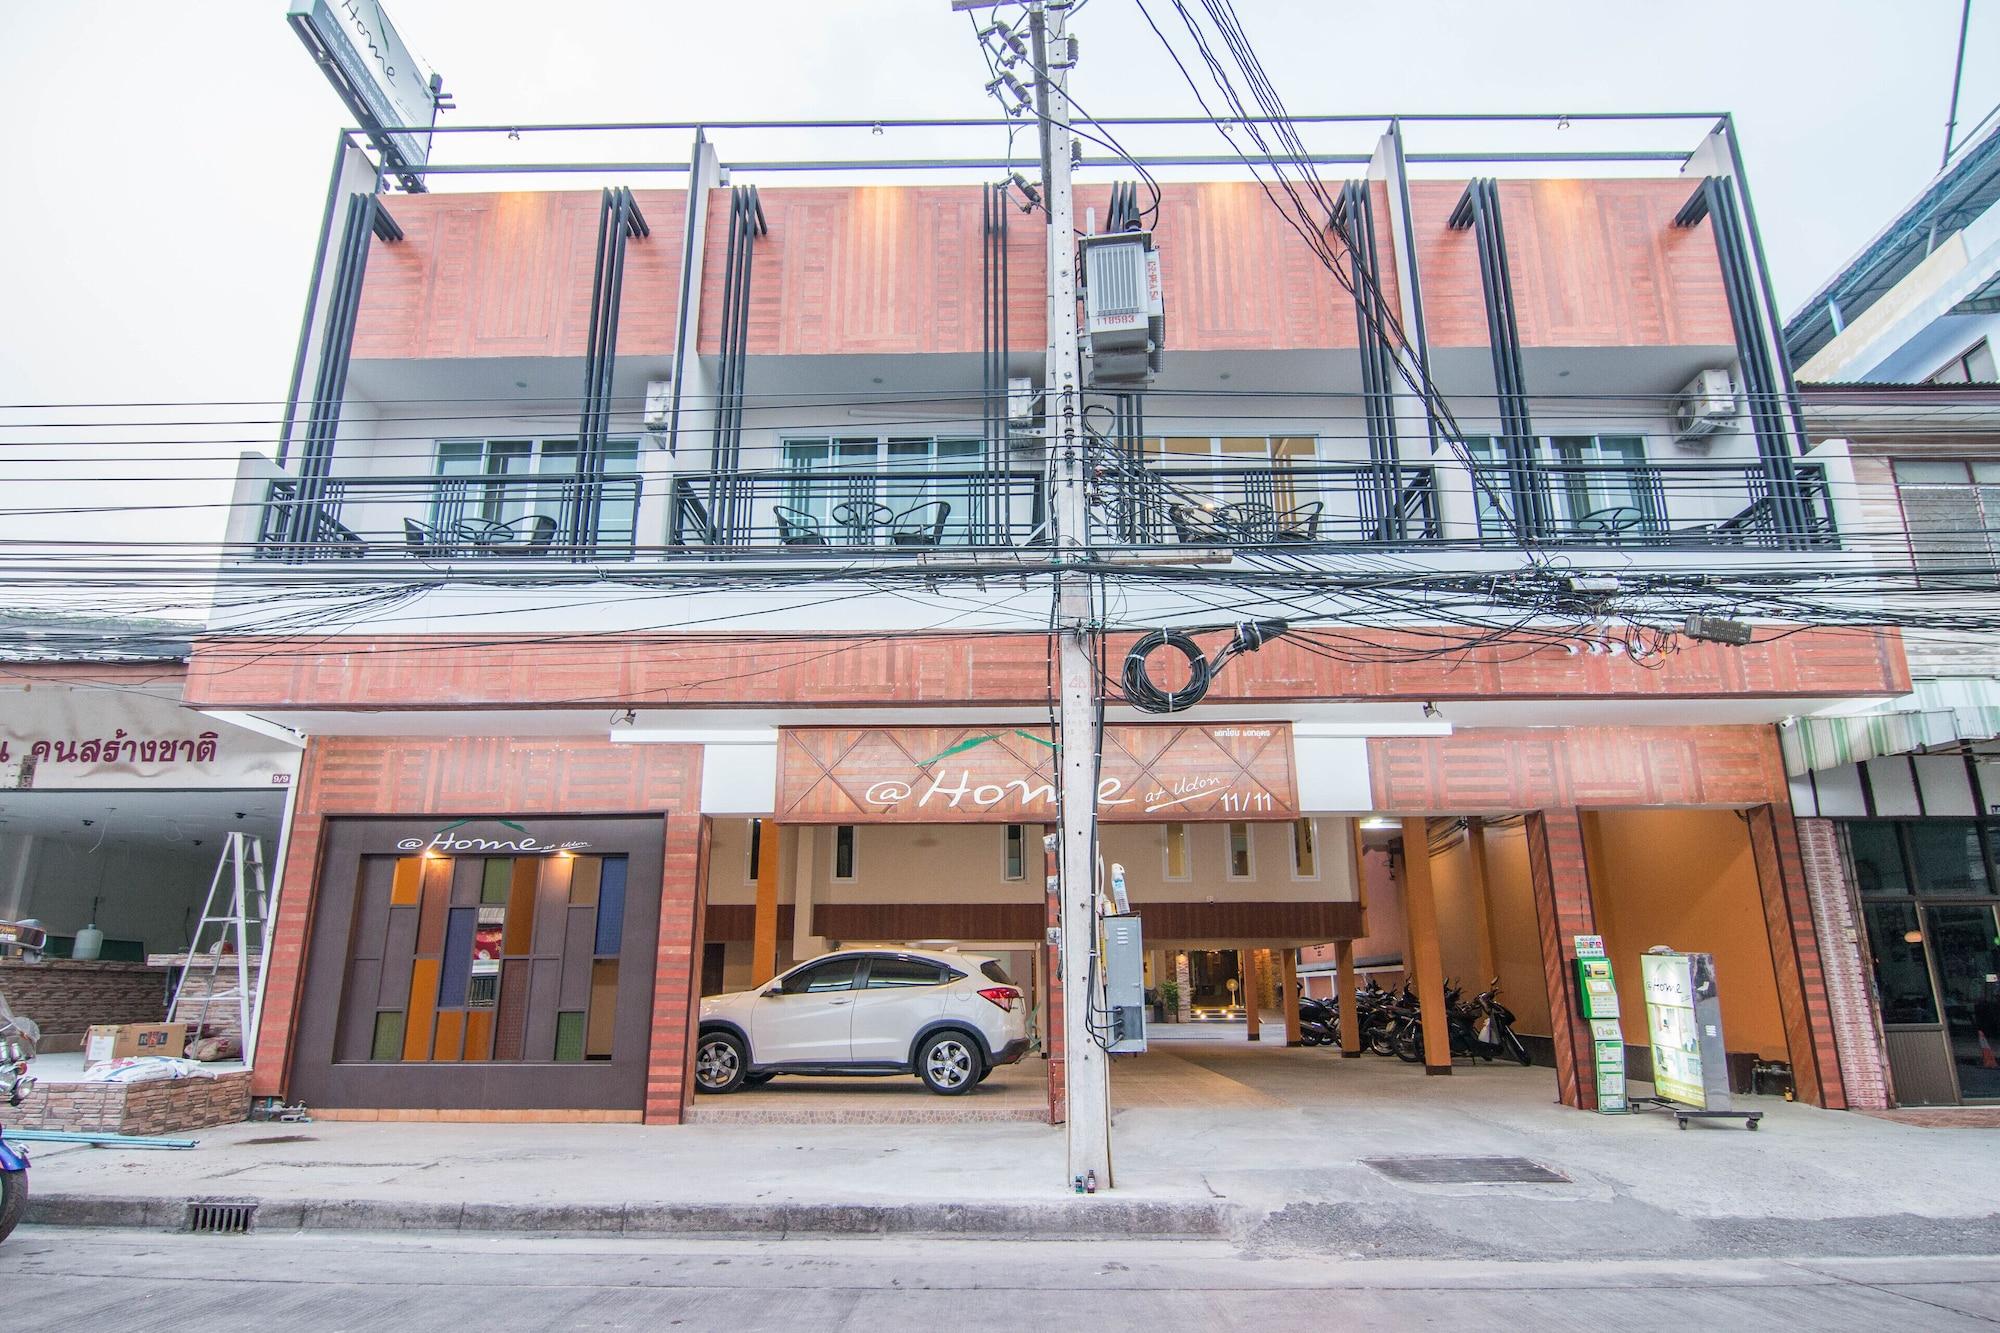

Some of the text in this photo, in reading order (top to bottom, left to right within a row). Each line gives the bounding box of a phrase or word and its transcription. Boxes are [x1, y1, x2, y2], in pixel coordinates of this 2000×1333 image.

[1096, 315, 1135, 326] 118583
[31, 728, 218, 763] คนสร้างชาติ
[273, 774, 289, 783] 9/9
[1173, 775, 1222, 795] Udon
[1221, 792, 1272, 812] 11/11
